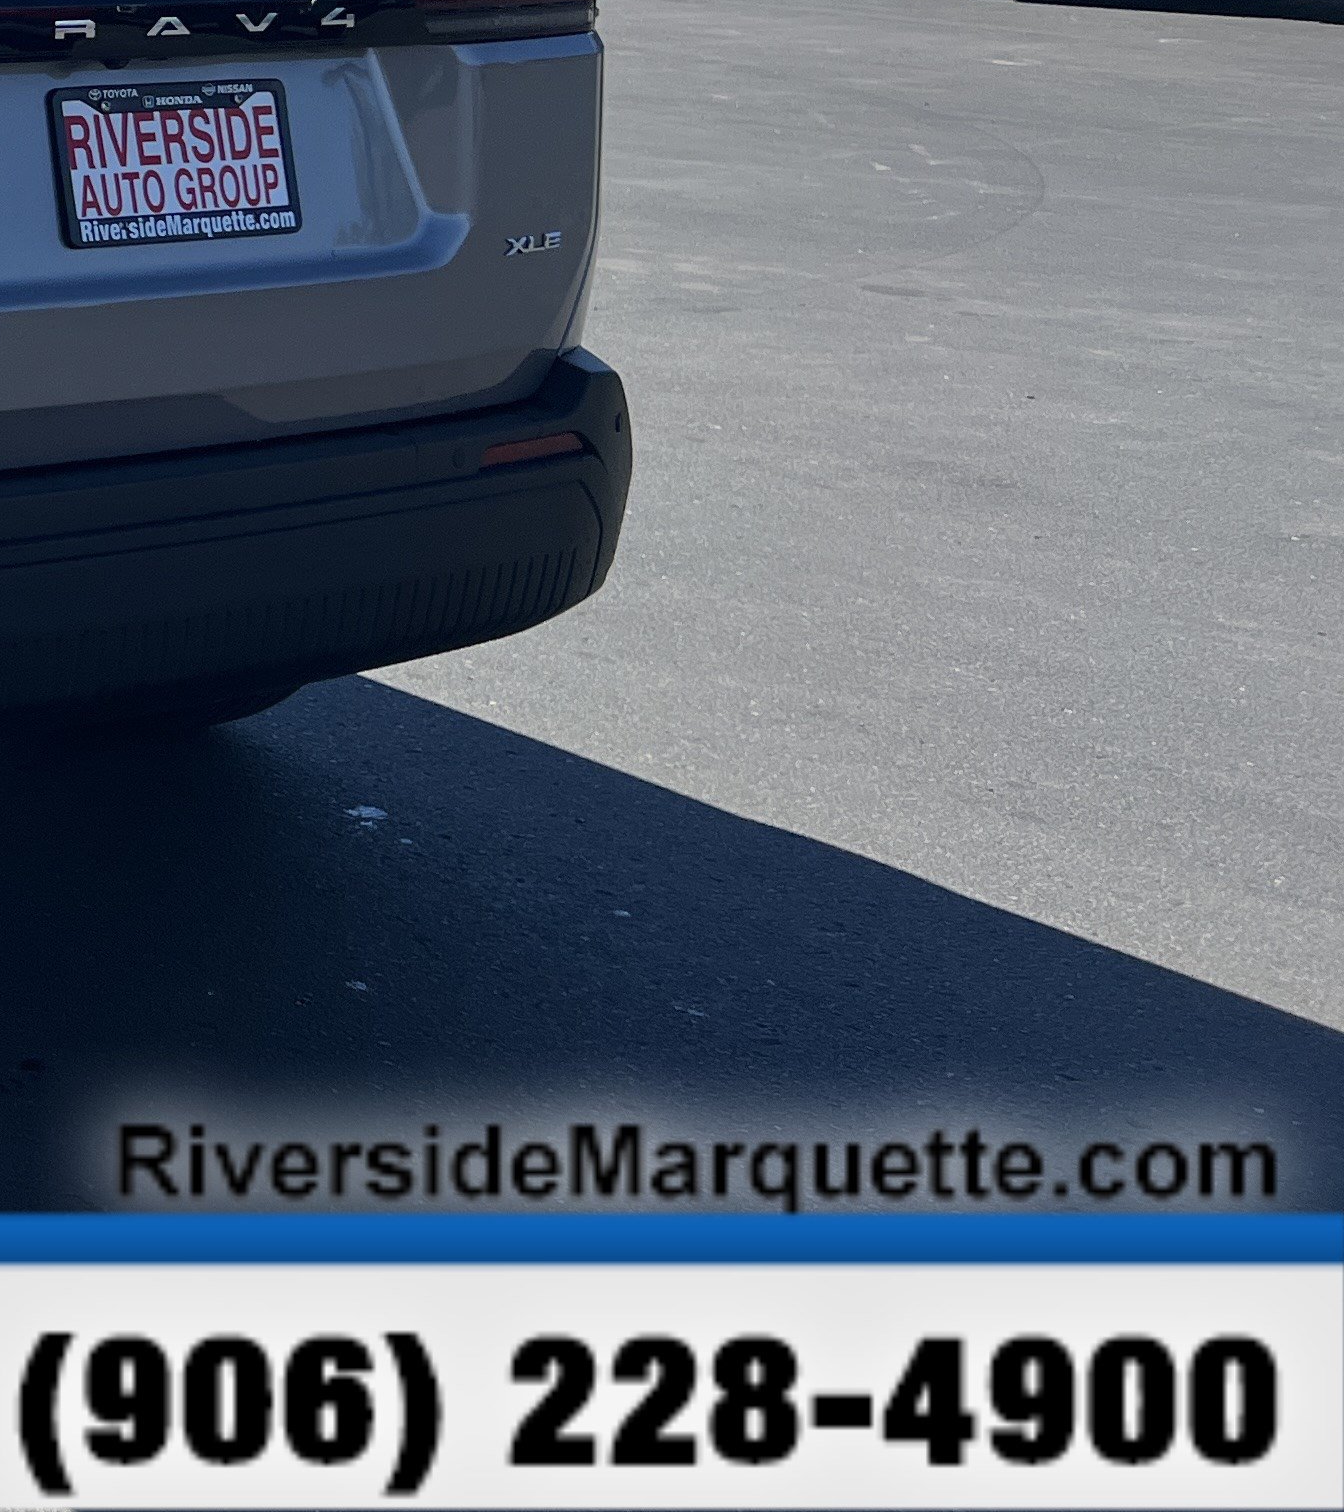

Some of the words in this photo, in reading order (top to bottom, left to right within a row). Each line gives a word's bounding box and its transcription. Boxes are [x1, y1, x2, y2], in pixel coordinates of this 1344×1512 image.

[54, 6, 356, 40] RAV4
[102, 88, 139, 99] TOYOTA
[155, 94, 203, 106] HONDA
[216, 83, 254, 94] NISSAN
[64, 105, 280, 170] RIVERSIDE
[80, 169, 166, 218] AUTO
[174, 163, 280, 211] GROUP
[79, 210, 297, 243] RiversideMarquette.com
[503, 231, 562, 256] XLE
